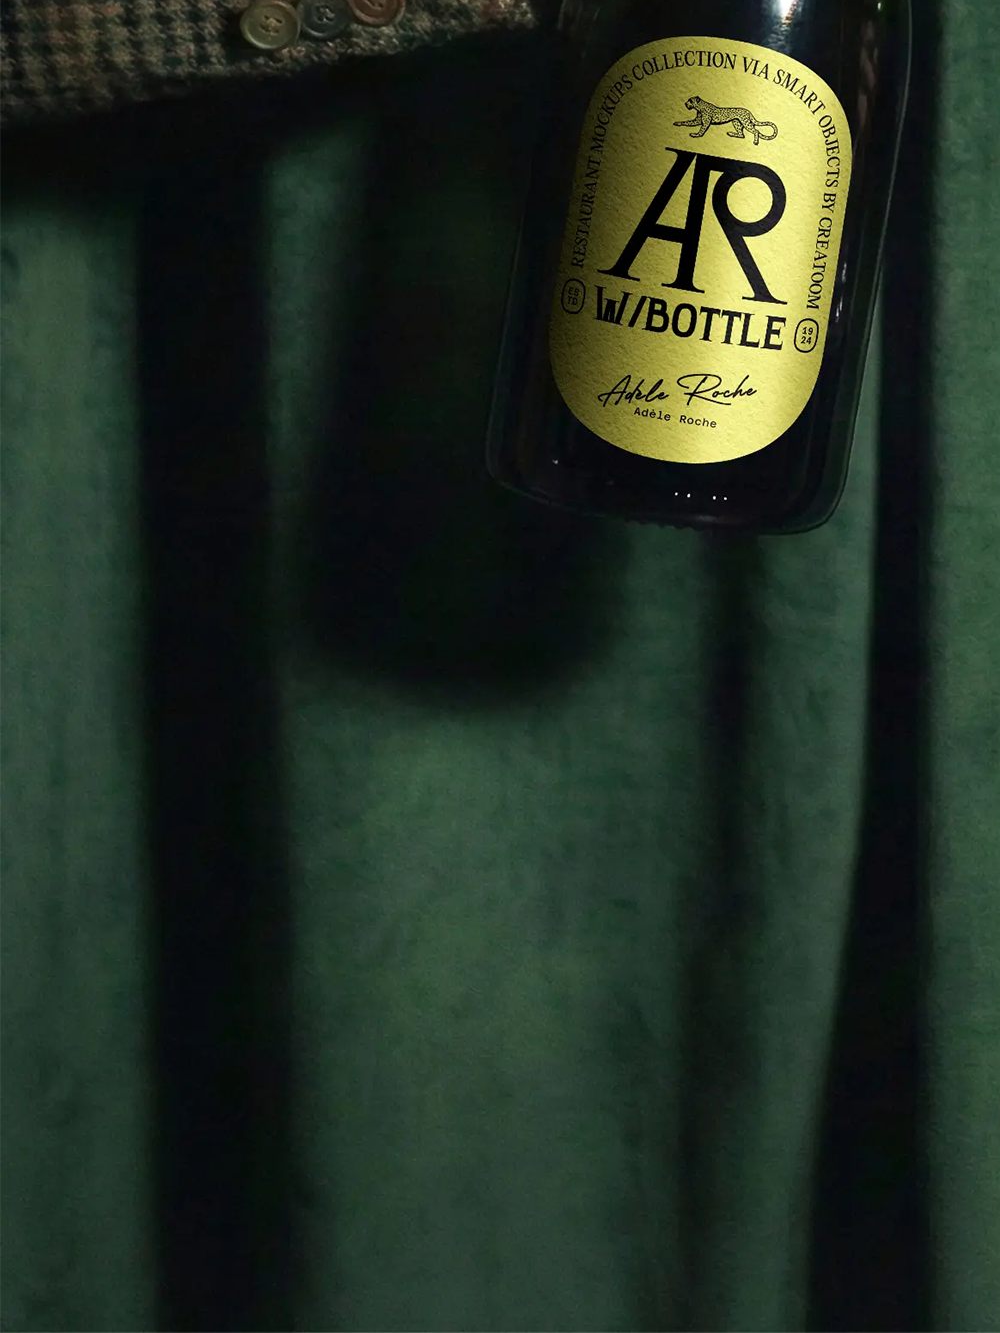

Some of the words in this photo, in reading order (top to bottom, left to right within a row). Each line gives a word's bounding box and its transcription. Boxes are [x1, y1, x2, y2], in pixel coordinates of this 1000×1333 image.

[632, 50, 737, 81] COLLECTION
[742, 56, 770, 81] VIA
[772, 68, 826, 116] SMART
[590, 74, 634, 155] MOCKUPS
[818, 114, 840, 189] OBJECTS
[570, 156, 602, 269] RESTAURANT
[822, 192, 838, 213] BY
[806, 216, 833, 310] CREATOOM
[676, 373, 758, 406] Roche
[633, 407, 671, 422] Adèle
[679, 414, 718, 429] Roche
